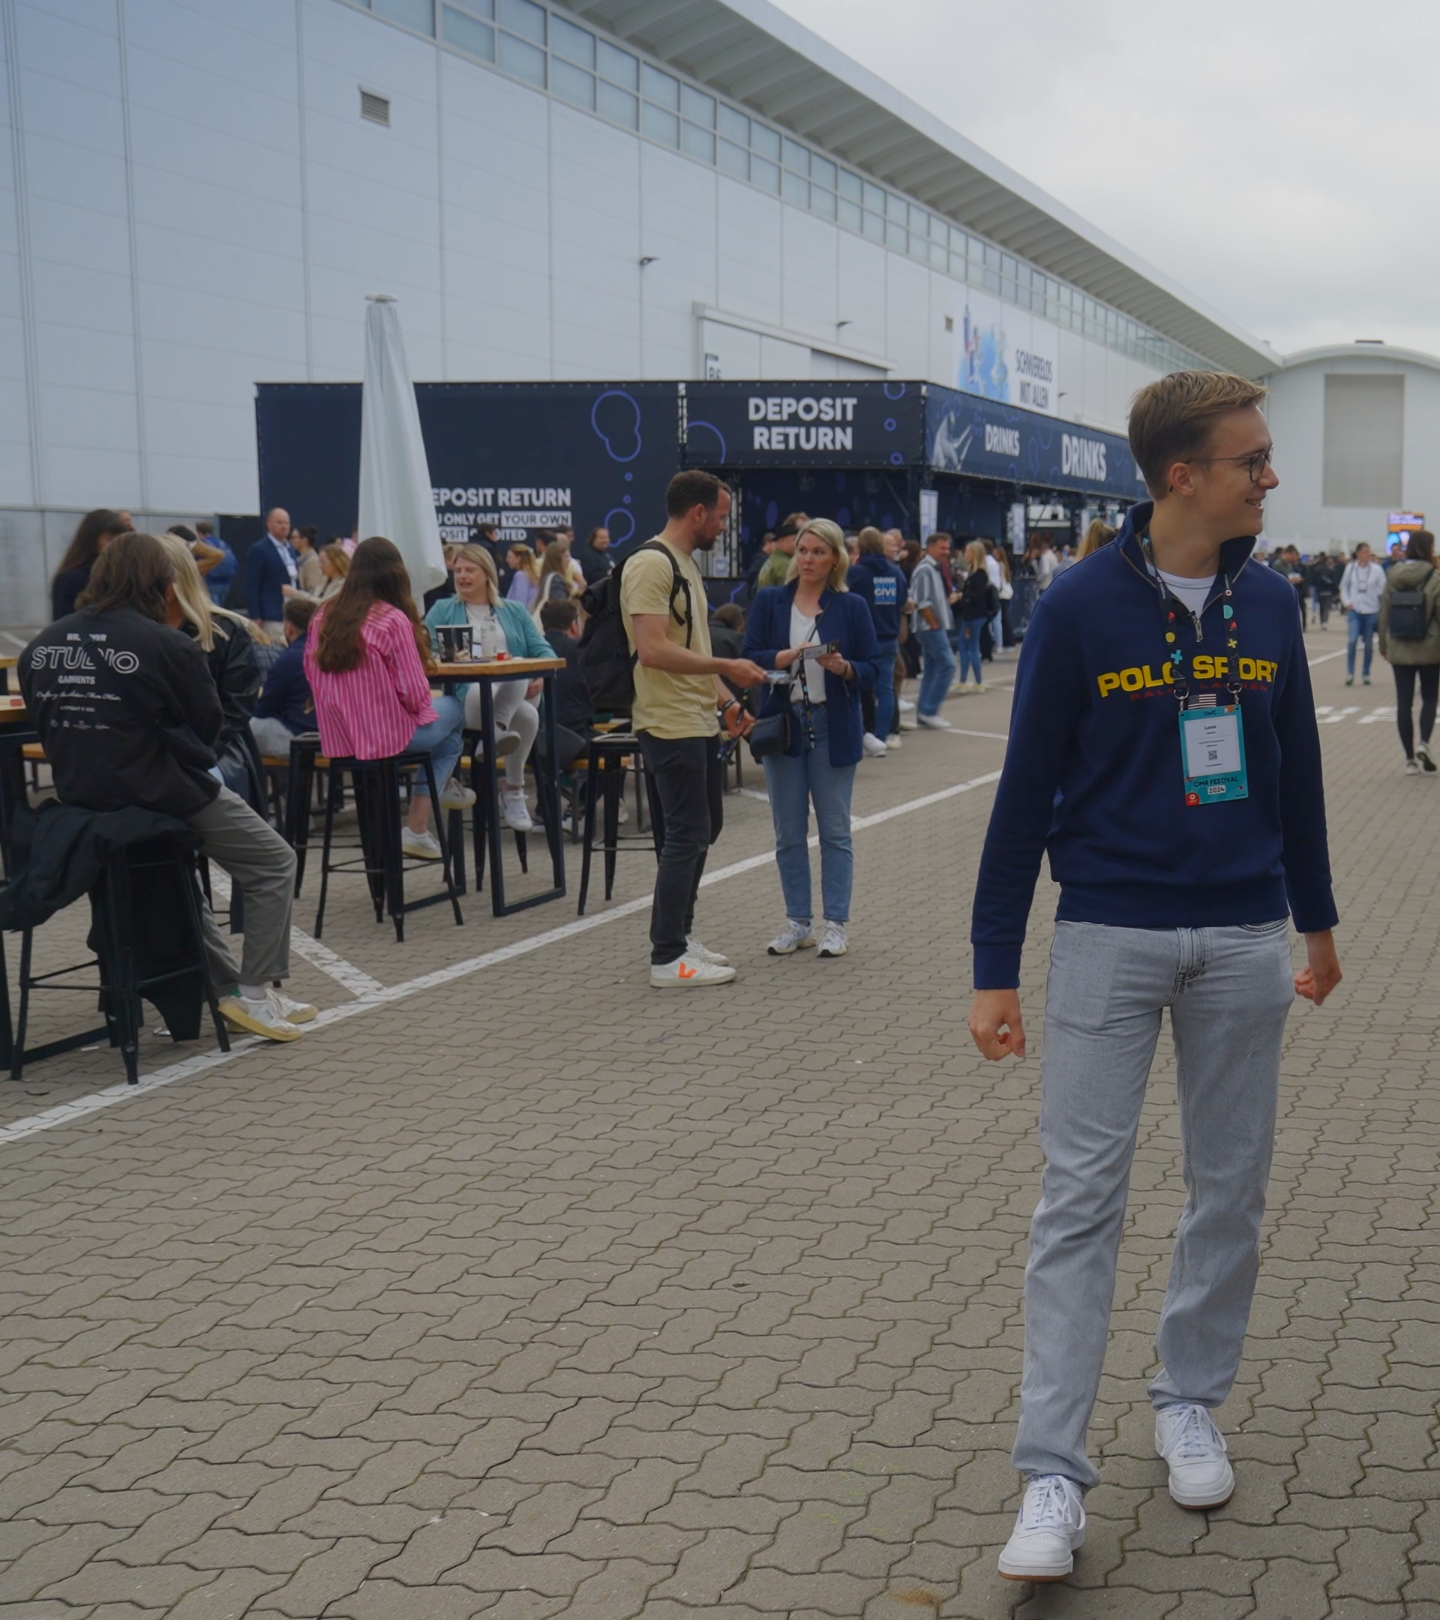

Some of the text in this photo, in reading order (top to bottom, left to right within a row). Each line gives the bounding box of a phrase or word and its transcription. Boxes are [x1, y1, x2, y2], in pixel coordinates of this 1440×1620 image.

[748, 397, 858, 422] DEPOSIT
[753, 426, 853, 450] RETURN
[984, 423, 1021, 458] DRINKS
[1061, 433, 1107, 482] DRINKS
[431, 488, 571, 507] EPOSIT RETURN
[444, 513, 475, 526] ONLY
[477, 513, 499, 525] GET
[504, 514, 536, 525] YOUR
[539, 514, 570, 525] OWN
[874, 588, 897, 597] GIVE
[1193, 776, 1239, 788] OMR FESTIVAL
[1208, 786, 1225, 794] 2024
